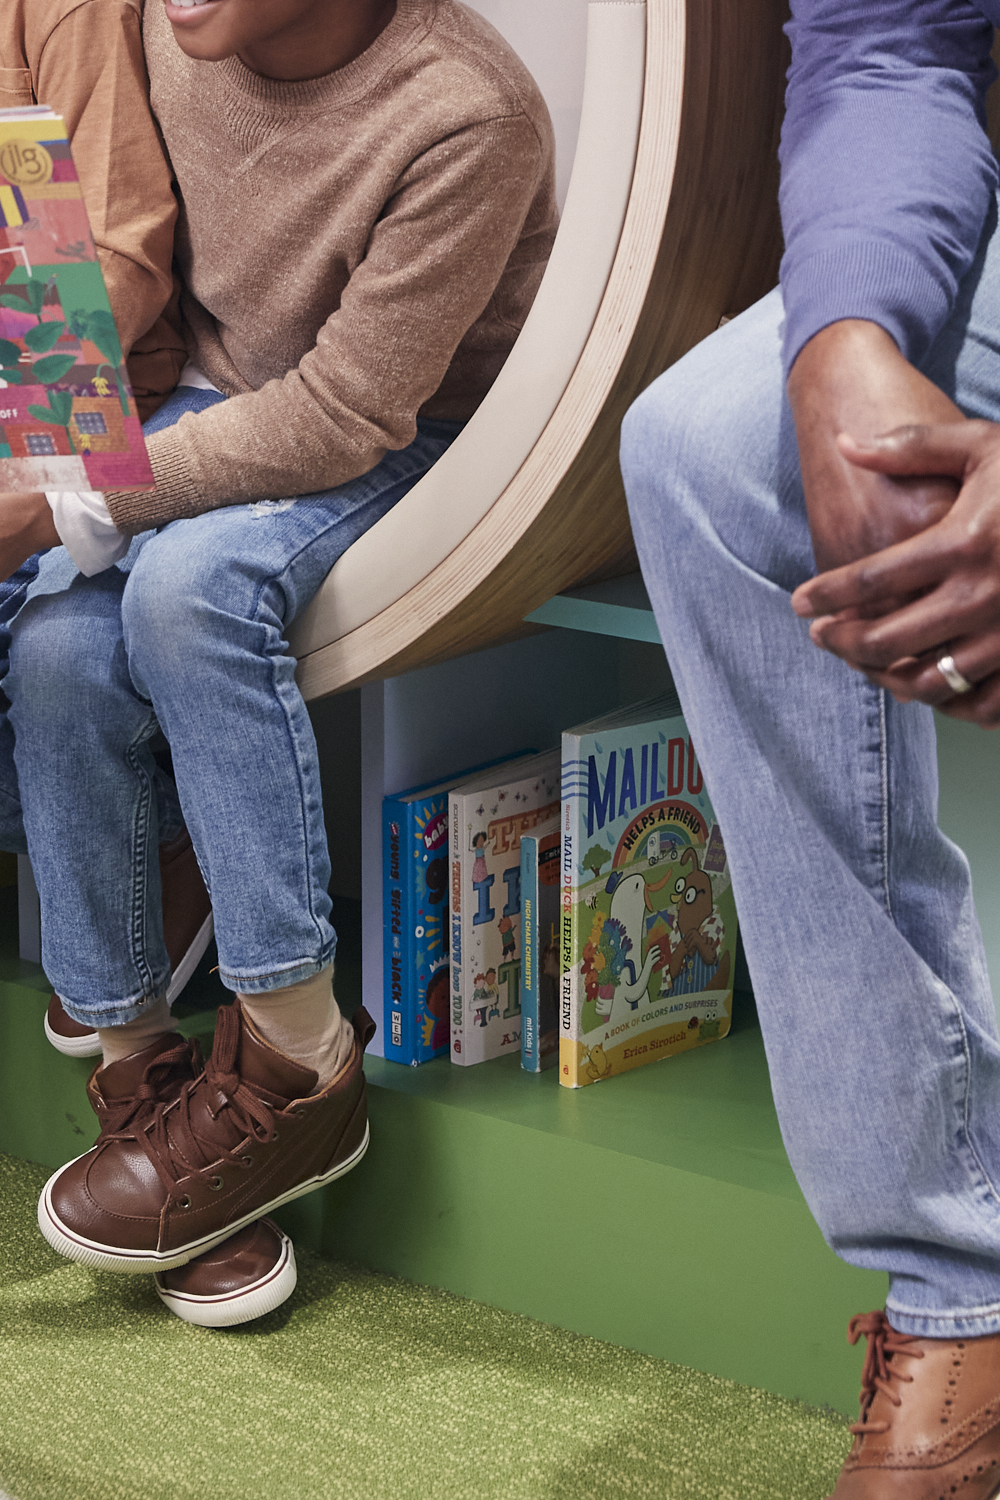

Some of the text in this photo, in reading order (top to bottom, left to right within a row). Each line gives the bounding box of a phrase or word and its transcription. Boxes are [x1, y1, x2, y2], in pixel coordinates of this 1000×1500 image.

[587, 742, 665, 838] MAIL
[622, 806, 701, 851] HELPS A FRIEND
[564, 834, 573, 872] MAIL
[472, 874, 496, 926] I
[563, 875, 572, 914] DUCK
[452, 861, 462, 1026] THINGS I KNOW how TO DO
[524, 899, 532, 991] HIGH CHAIR CHEMISTRY
[563, 916, 572, 963] HELPS
[391, 957, 402, 1001] black
[563, 964, 571, 975] A
[562, 976, 571, 1030] FRIEND
[604, 999, 718, 1041] A BOOK OF COLORS AND SURPRISES
[526, 1031, 534, 1049] Kids
[622, 1031, 687, 1059] Erica Sirotich
